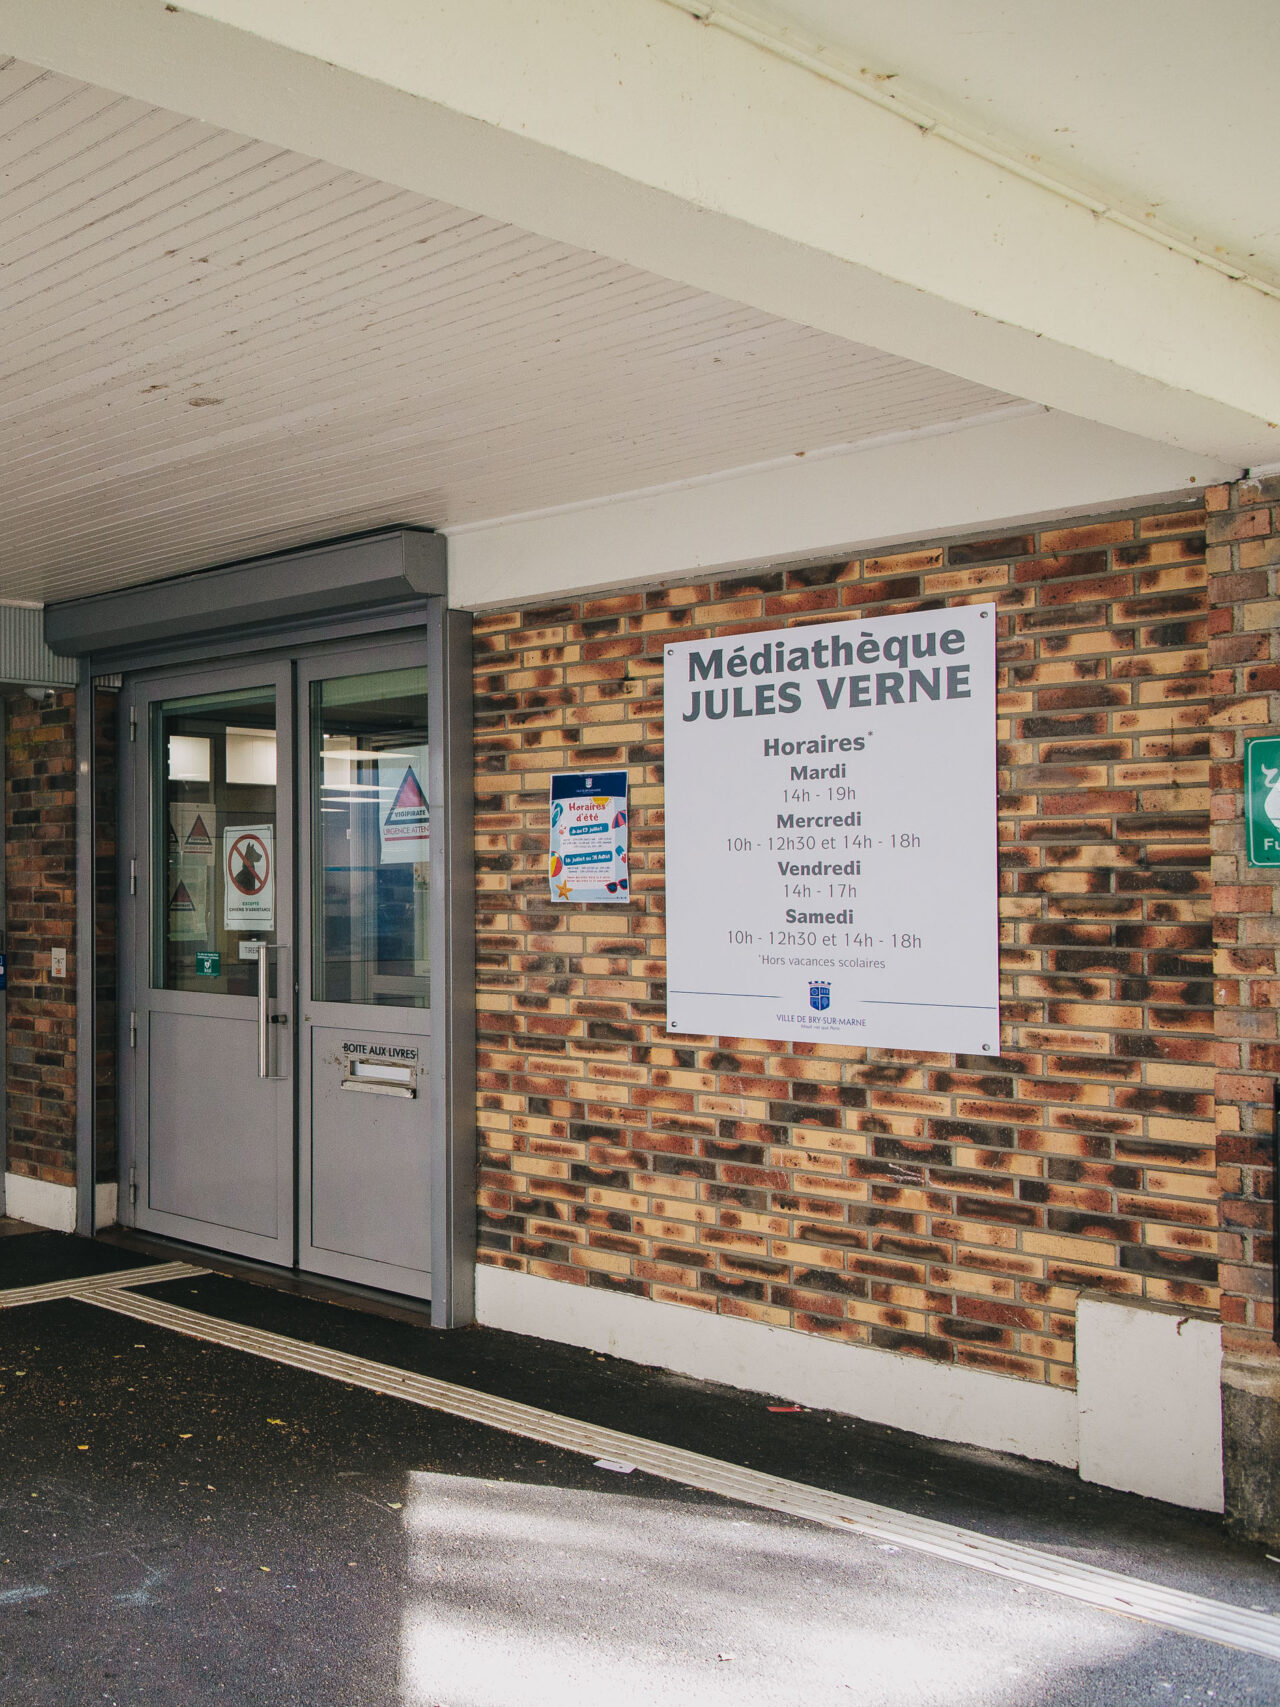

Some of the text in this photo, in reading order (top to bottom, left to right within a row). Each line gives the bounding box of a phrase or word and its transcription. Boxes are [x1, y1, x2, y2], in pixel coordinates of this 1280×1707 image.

[688, 629, 965, 682] Médiathèque
[683, 664, 971, 722] JULES VERNE
[791, 763, 846, 781] Mardi
[784, 789, 810, 802] 14h
[829, 787, 855, 800] 19h
[394, 809, 426, 817] VIGIPIRATE
[569, 802, 606, 811] Horaires
[576, 813, 599, 822] d'été
[777, 811, 861, 828] Mercredi
[383, 826, 410, 835] URGENCE
[728, 838, 751, 851] 10h
[769, 836, 815, 850] 12h30
[822, 837, 836, 849] et
[845, 835, 871, 848] 14h
[891, 834, 920, 848] 18h
[778, 860, 860, 876] Vendredi
[785, 884, 810, 898] 14h
[829, 884, 856, 898] 17h
[786, 909, 853, 924] Samedi
[729, 931, 752, 944] 10h
[770, 931, 816, 945] 12h30
[823, 934, 837, 946] et
[845, 933, 872, 947] 14h
[892, 934, 921, 948] 18h
[789, 958, 835, 966] vacances
[839, 958, 885, 968] scolaires
[777, 1014, 794, 1022] VILLE
[343, 1043, 416, 1059] BOITE AUX LIVRES
